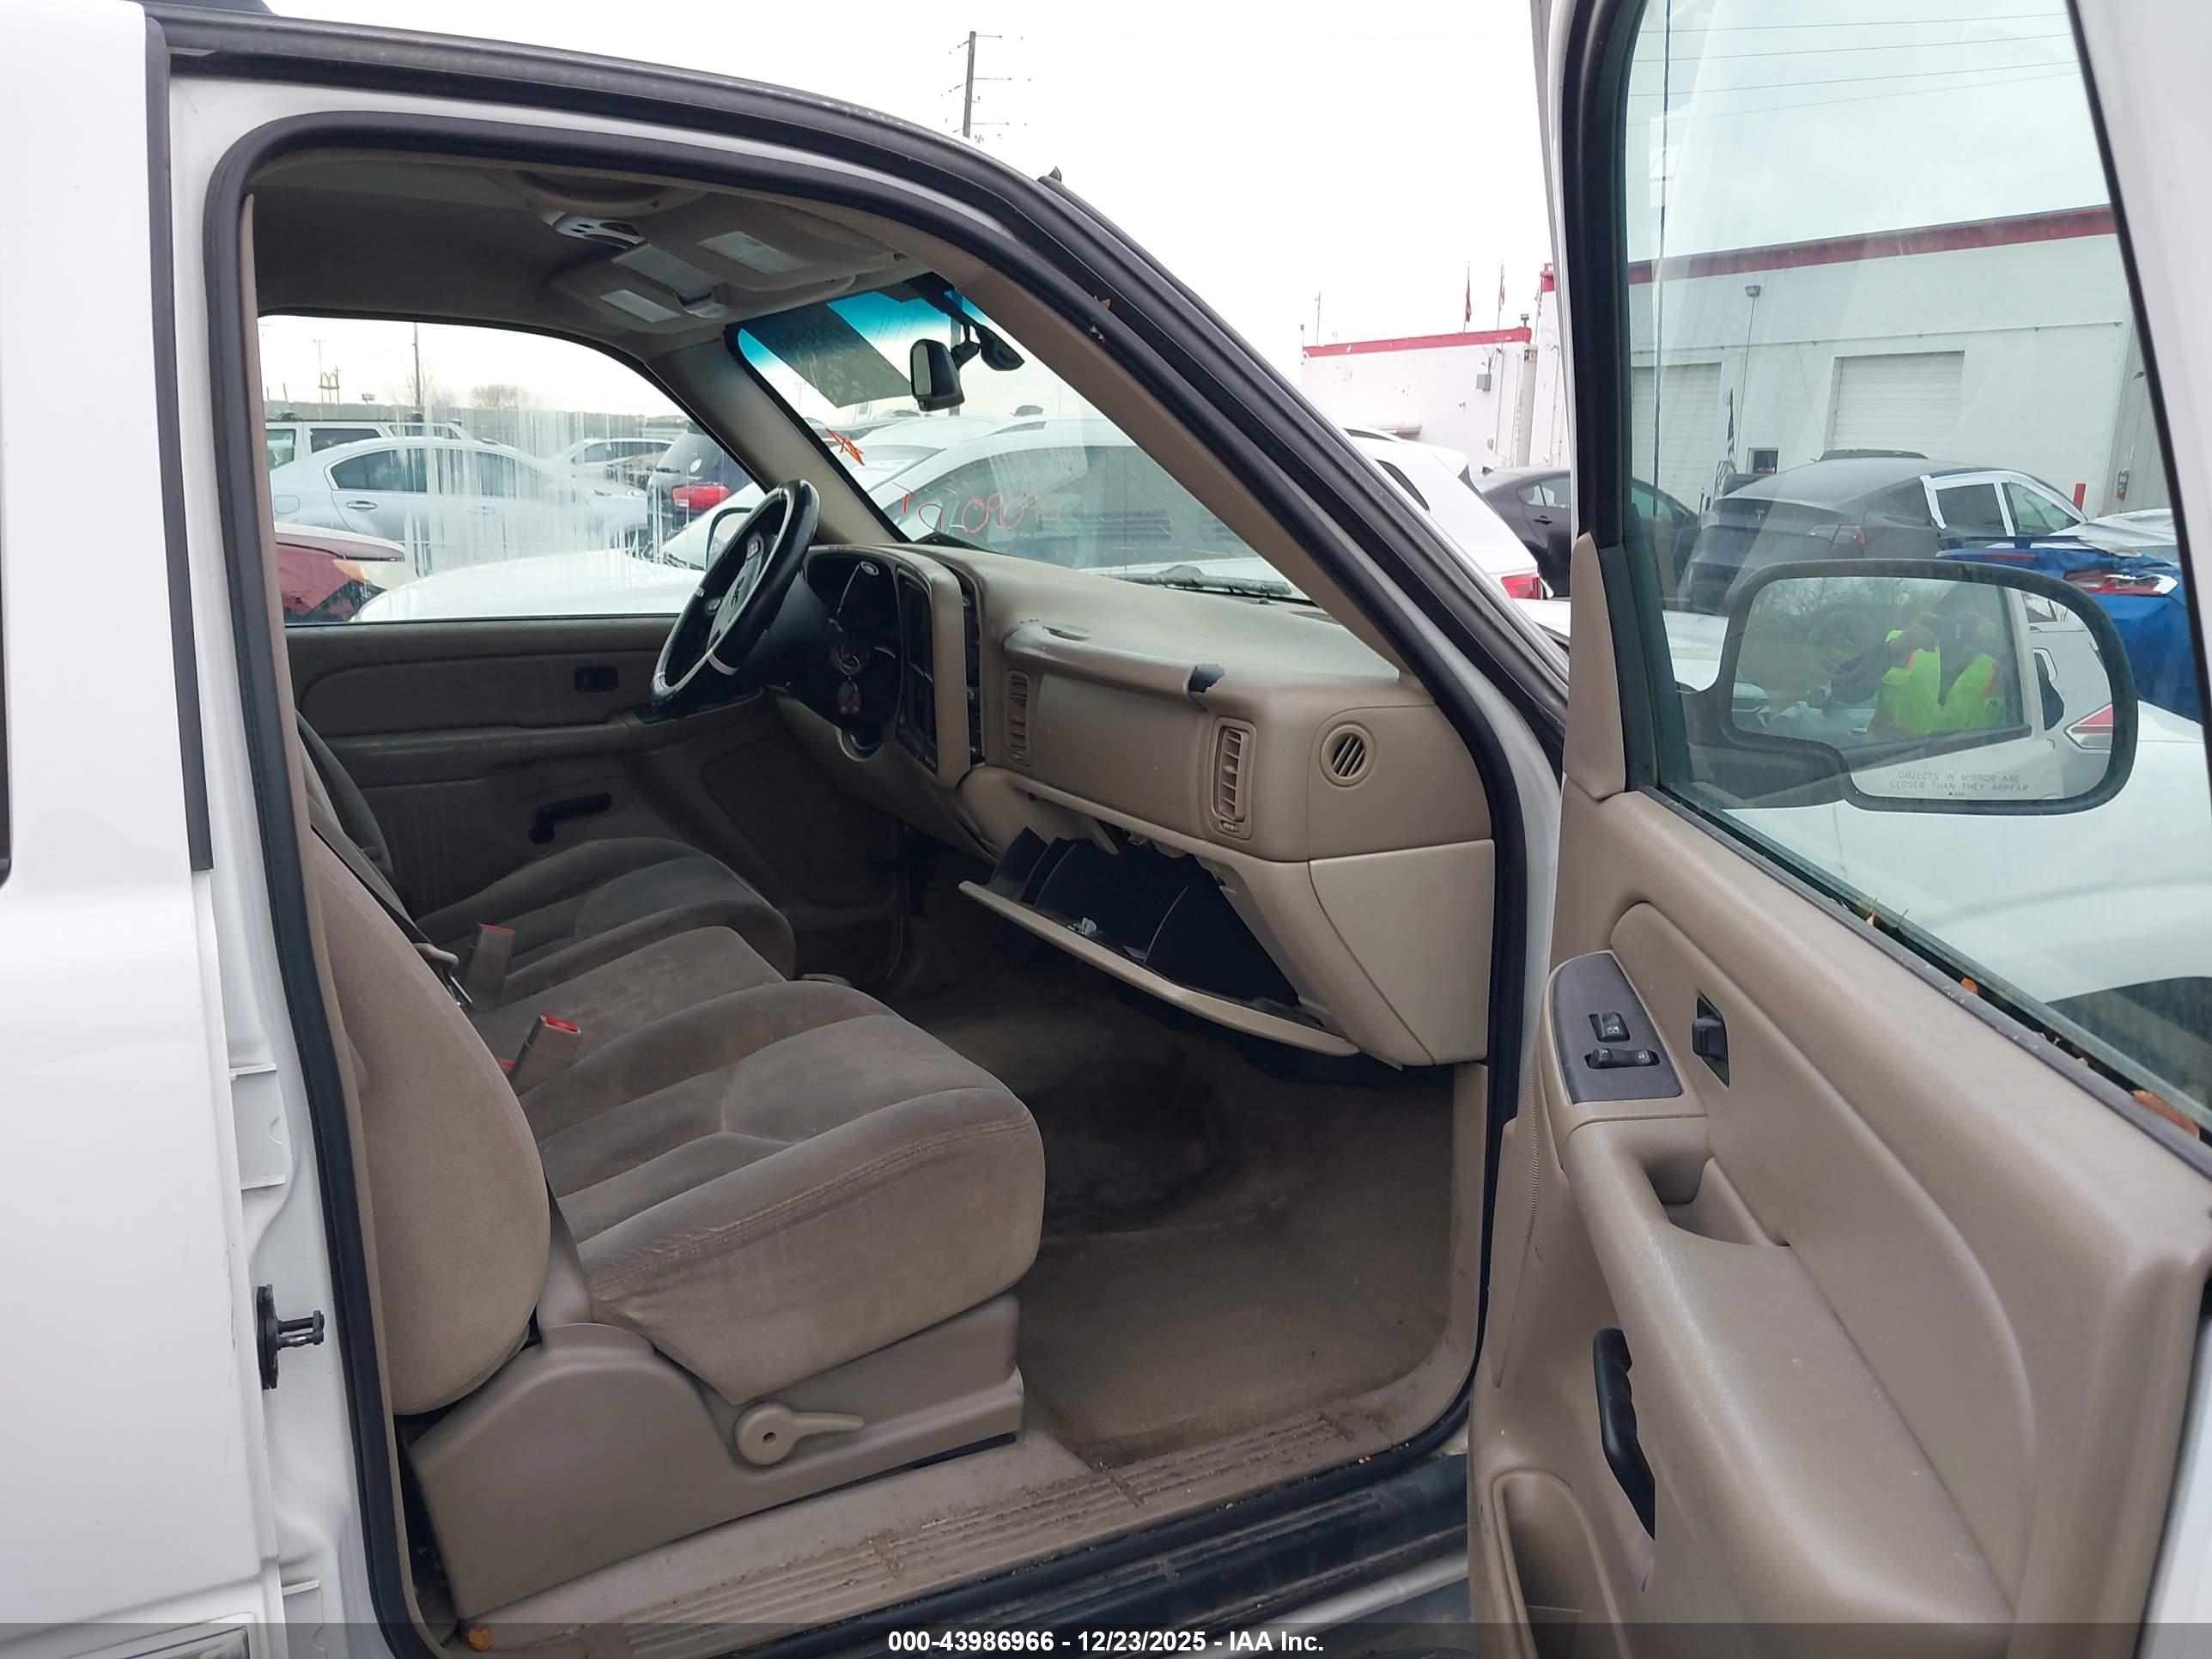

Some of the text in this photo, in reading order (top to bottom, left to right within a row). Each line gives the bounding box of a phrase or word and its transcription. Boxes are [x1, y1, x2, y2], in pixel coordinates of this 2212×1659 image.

[731, 576, 745, 607] GMC
[1899, 771, 1939, 781] OBJECTS
[1961, 774, 1996, 782] MIRROR
[2002, 775, 2021, 783] ARE
[1890, 780, 2029, 793] CLOSER THAN THEY APPEAR
